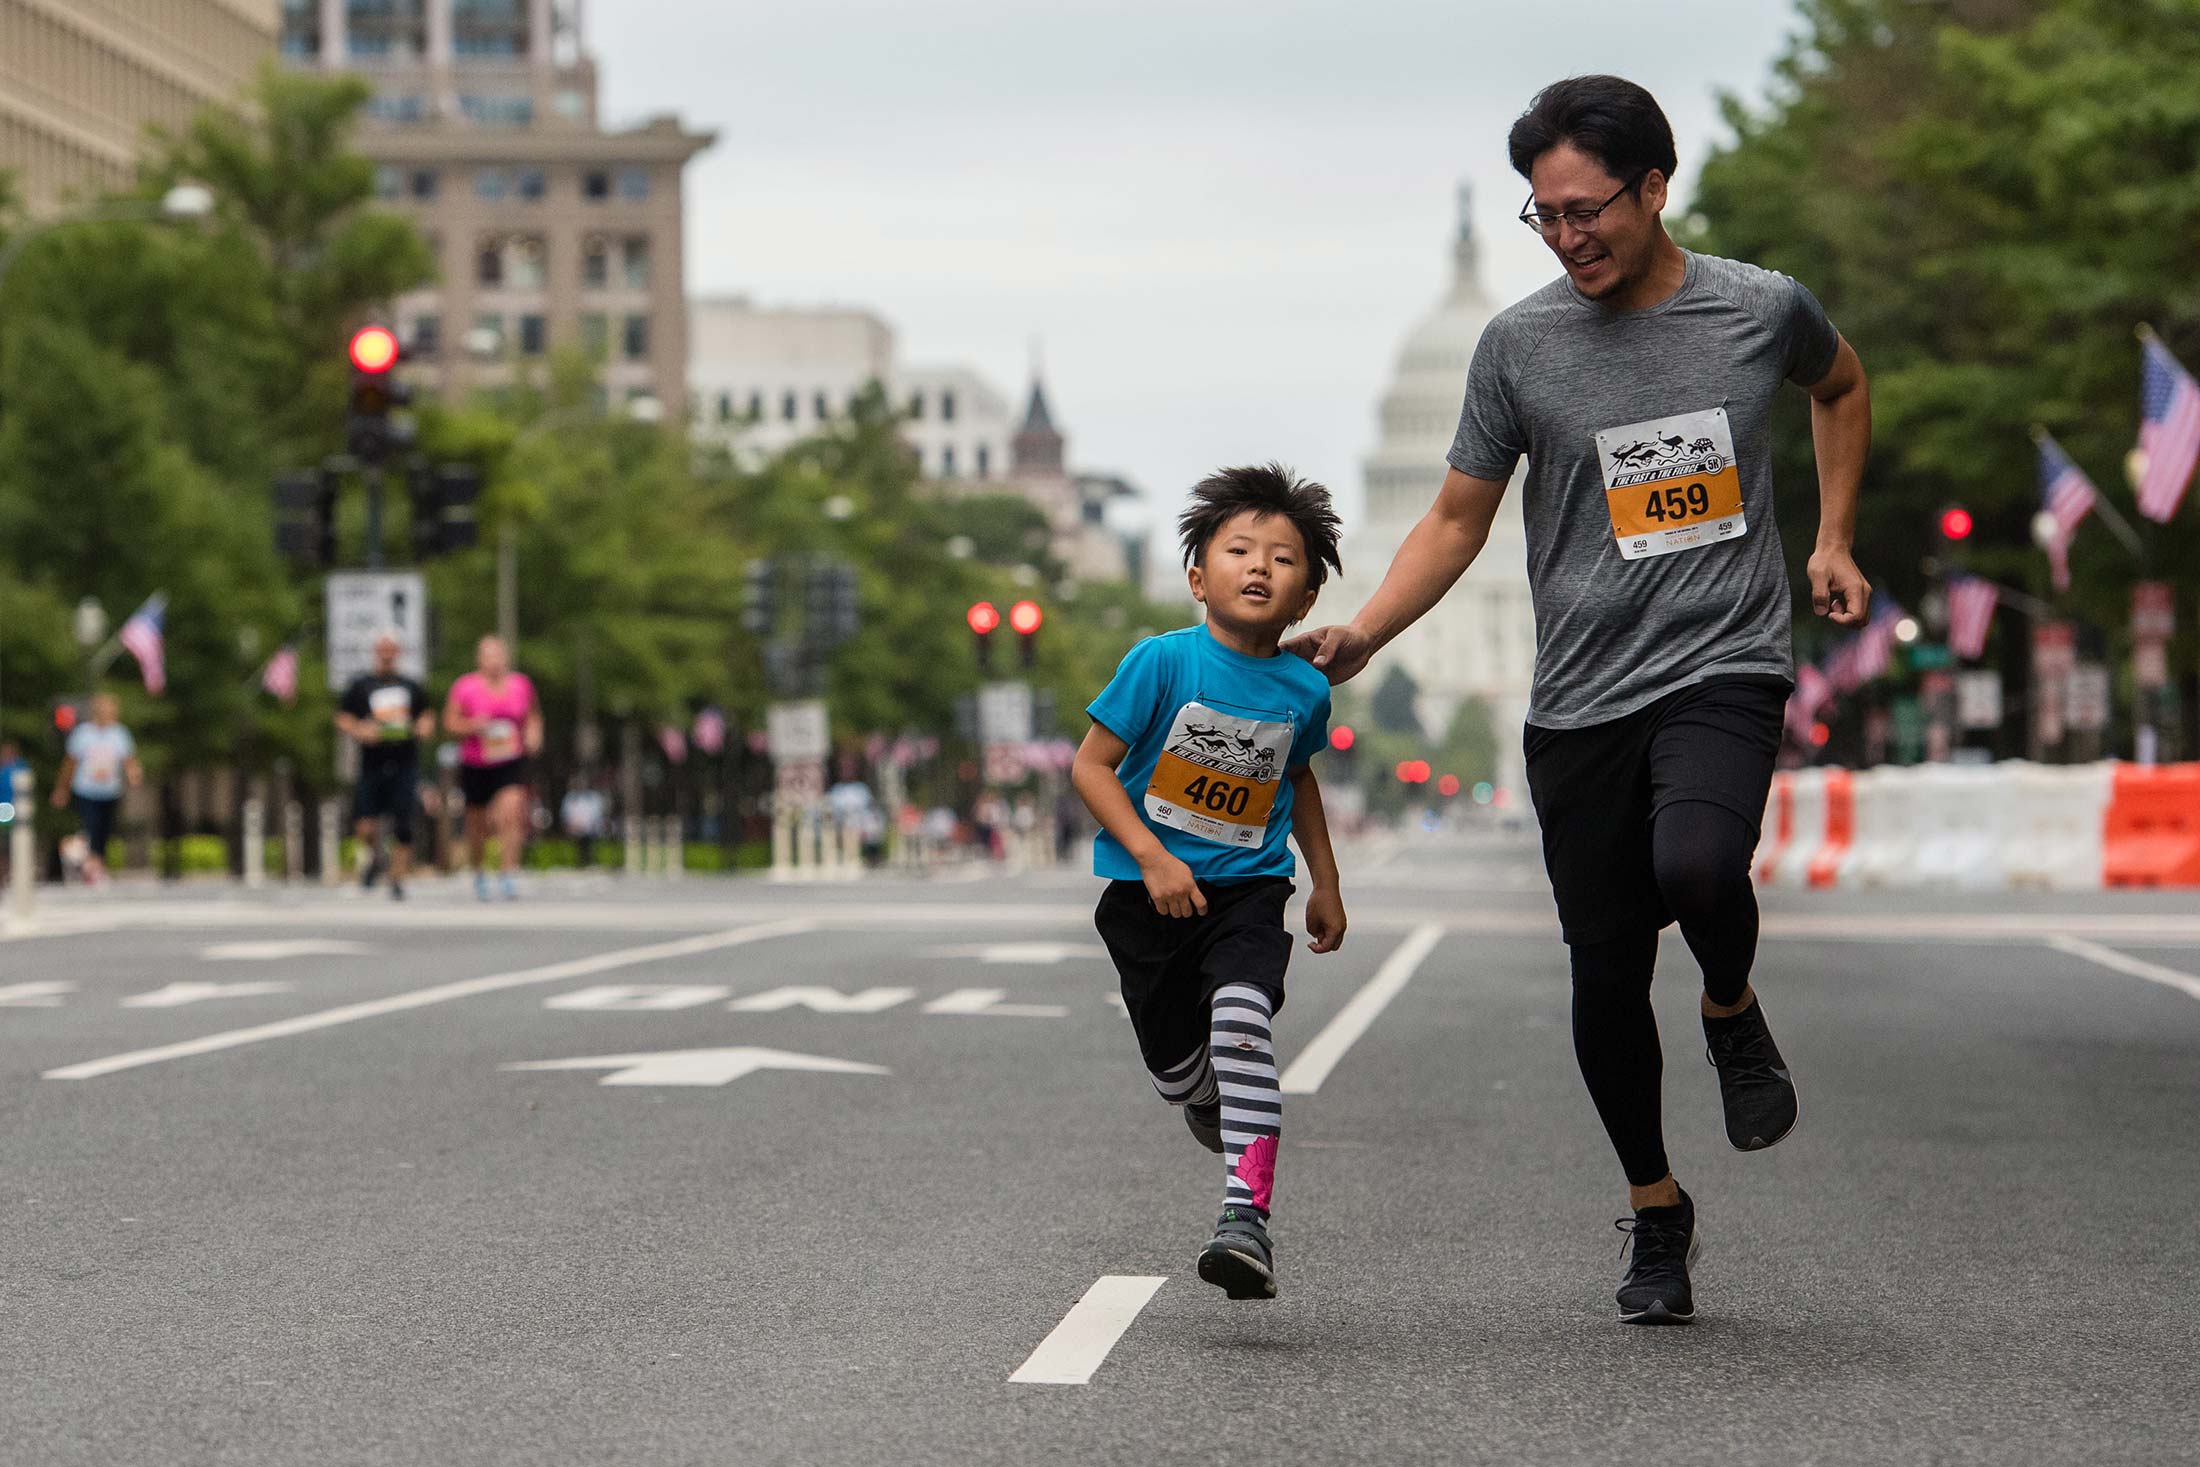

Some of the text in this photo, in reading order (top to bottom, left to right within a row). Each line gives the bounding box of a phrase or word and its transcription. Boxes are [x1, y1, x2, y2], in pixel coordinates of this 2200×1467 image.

[1707, 458, 1719, 470] 5K
[1615, 476, 1630, 487] THE
[1630, 473, 1650, 484] FAST
[1658, 468, 1672, 479] THE
[1672, 463, 1699, 476] FIERCE
[1646, 483, 1708, 522] 459
[1719, 521, 1733, 530] 459
[1633, 540, 1647, 549] 459
[1666, 534, 1700, 546] NATION
[1173, 747, 1190, 757] THE
[1187, 753, 1208, 764] FAST
[1215, 761, 1232, 772] THE
[1184, 776, 1249, 816] 460
[1157, 805, 1172, 816] 460
[1187, 820, 1222, 836] NATION
[1240, 830, 1253, 839] 460
[543, 984, 1130, 1018] ONL
